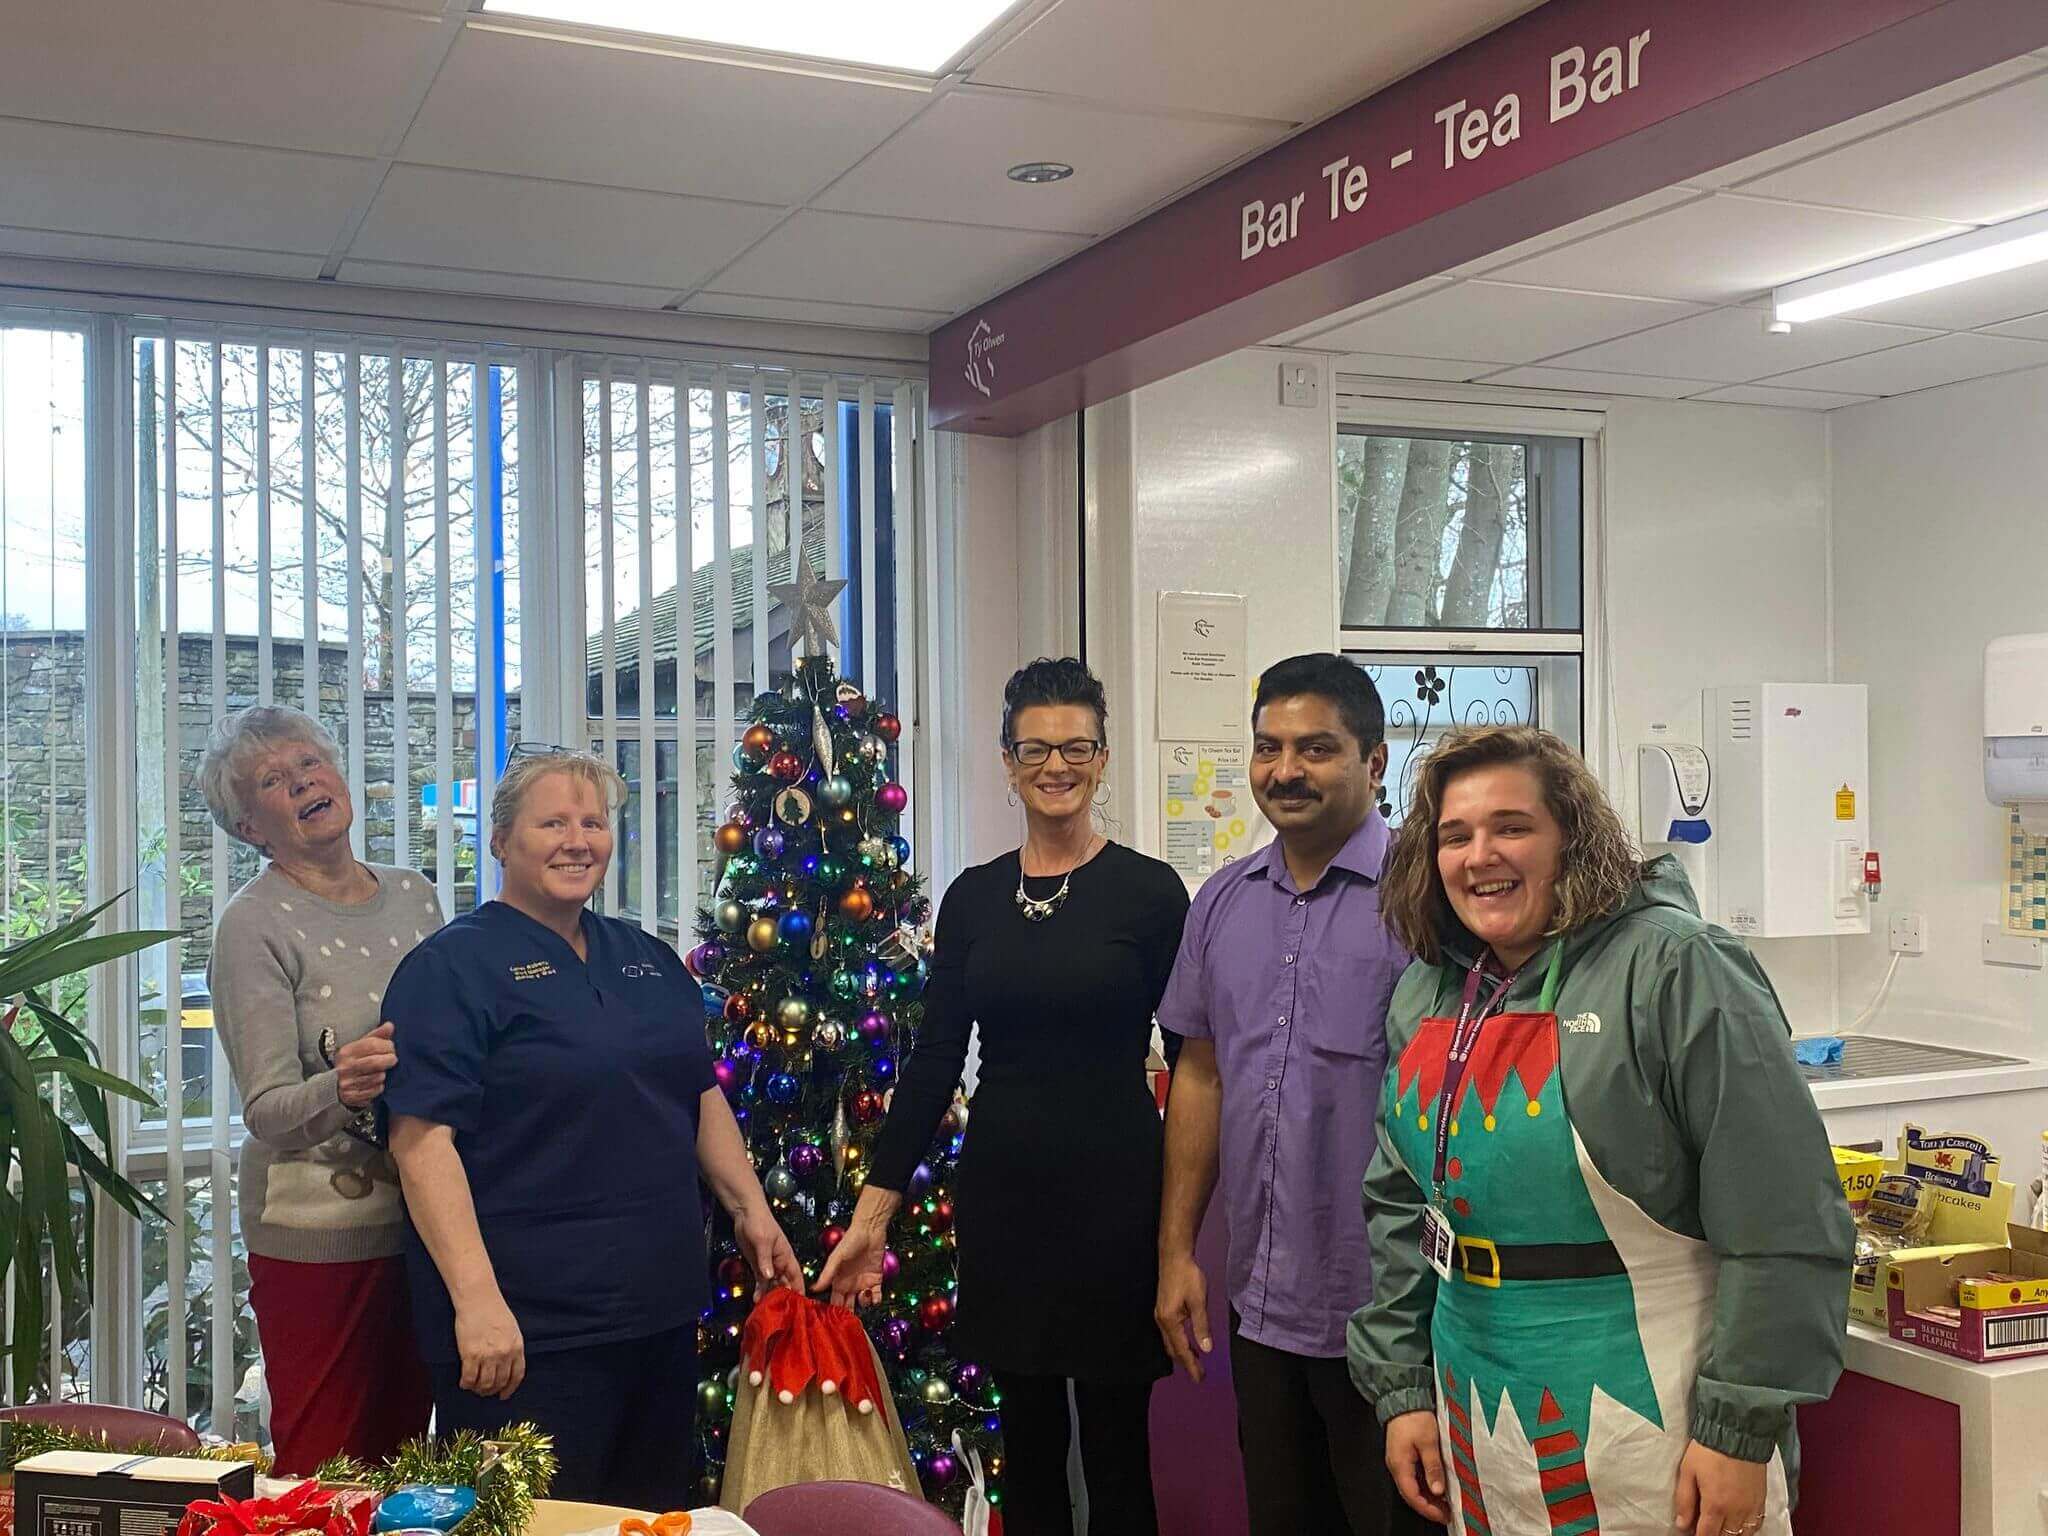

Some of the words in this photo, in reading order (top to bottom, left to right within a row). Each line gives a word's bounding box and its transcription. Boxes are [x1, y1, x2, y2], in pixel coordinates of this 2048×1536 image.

[1240, 190, 1305, 261] Bar
[1321, 154, 1369, 221] Te
[1433, 98, 1521, 171] Tea
[1549, 28, 1651, 125] Bar
[1921, 1324, 1960, 1341] BAKEWELL
[1921, 1334, 1959, 1351] FLAPJACK
